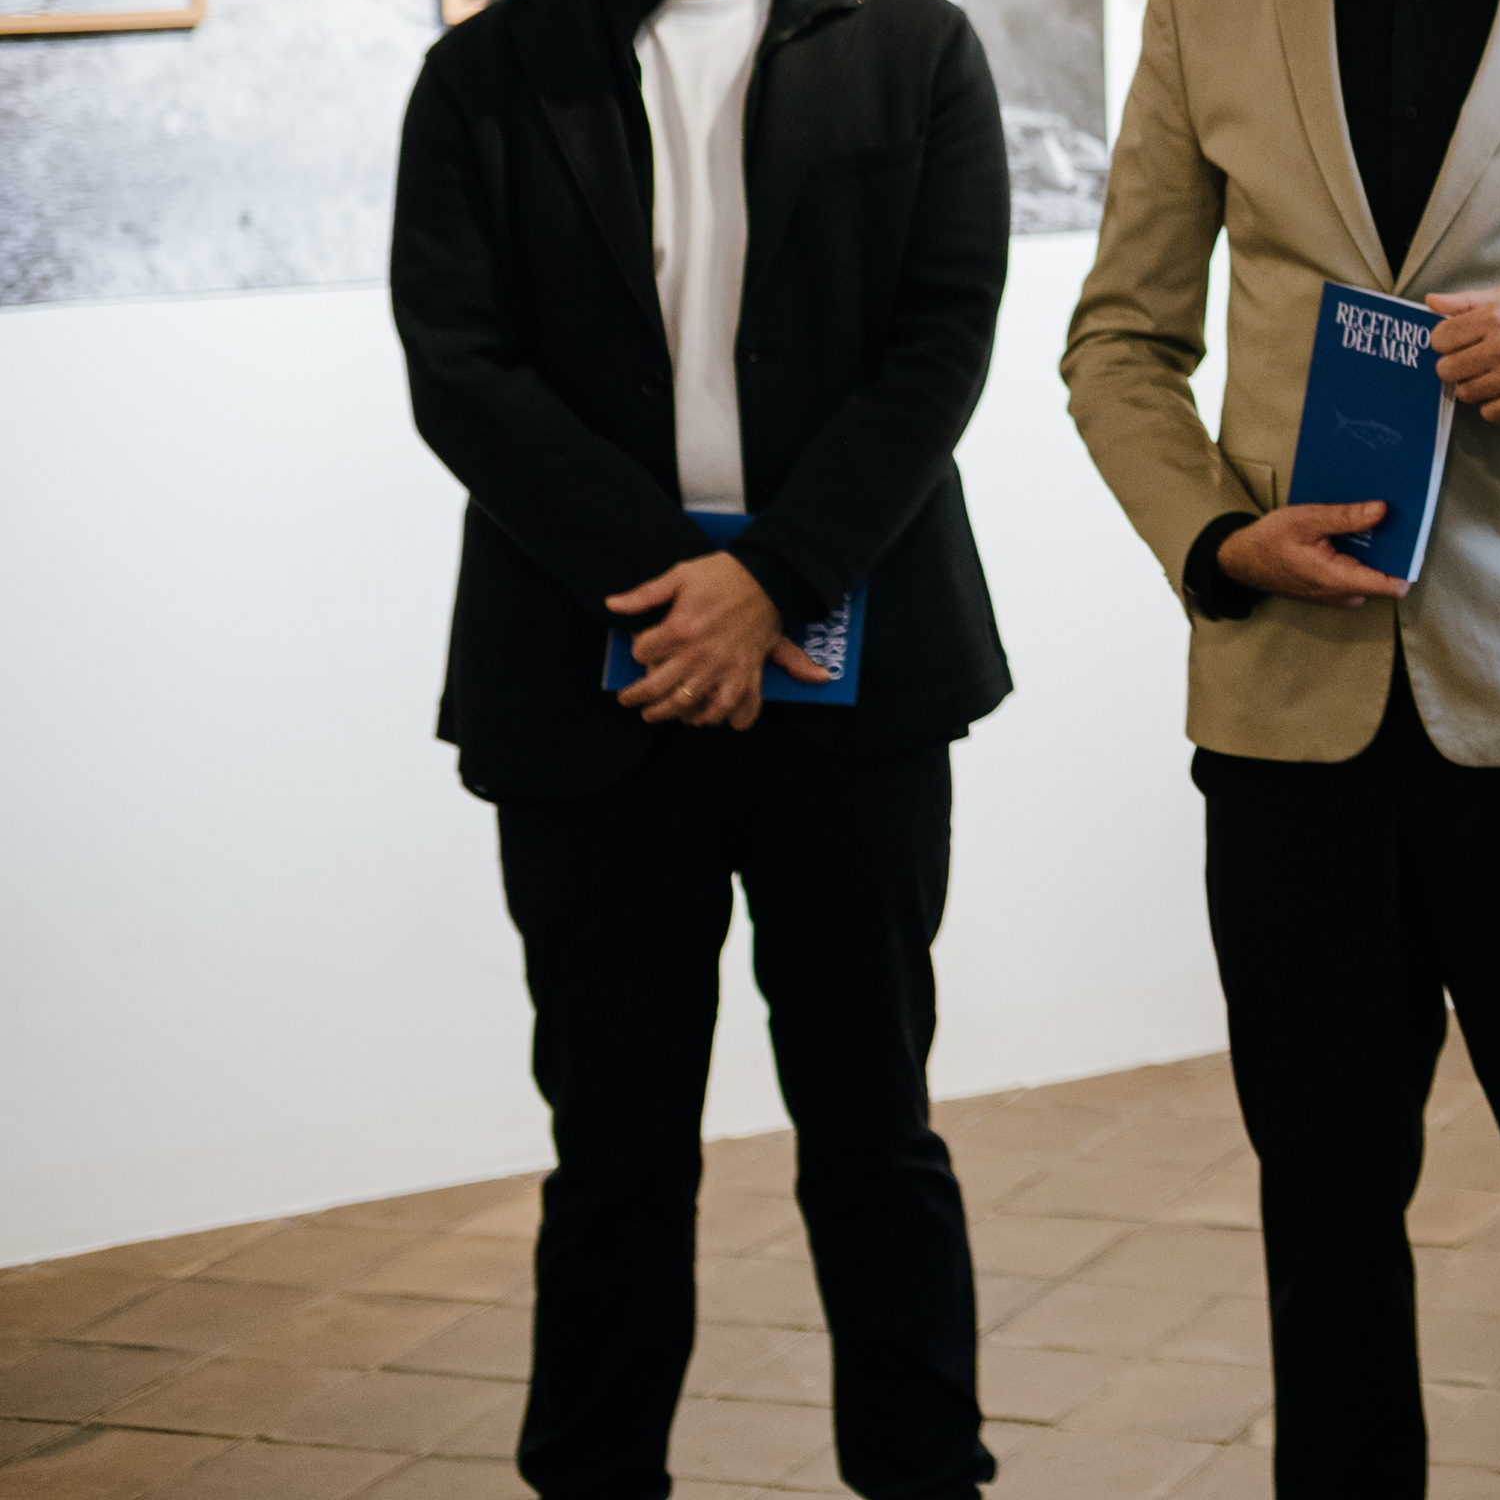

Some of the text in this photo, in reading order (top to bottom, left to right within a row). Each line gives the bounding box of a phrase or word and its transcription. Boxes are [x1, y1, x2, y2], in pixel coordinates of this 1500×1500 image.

[1336, 301, 1431, 349] RECETARIO
[1342, 326, 1418, 368] DEL MAR
